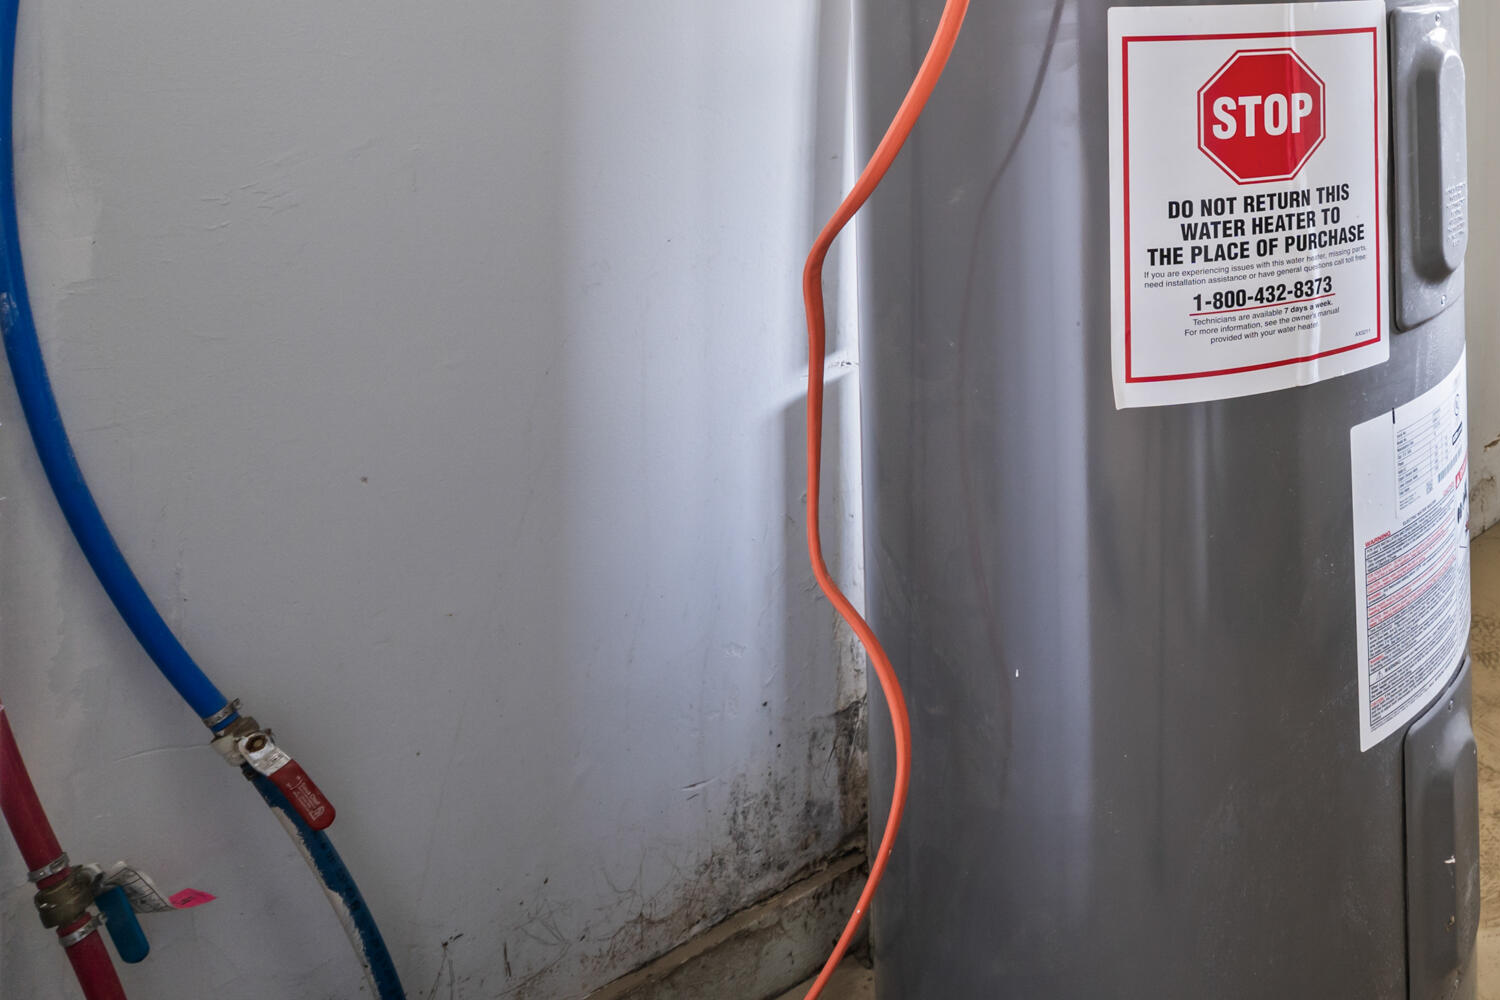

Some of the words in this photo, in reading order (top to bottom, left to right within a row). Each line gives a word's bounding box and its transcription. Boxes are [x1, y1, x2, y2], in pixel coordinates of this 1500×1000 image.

[1212, 93, 1313, 140] STOP
[1168, 200, 1194, 219] DO
[1200, 197, 1237, 217] NOT
[1243, 189, 1311, 214] RETURN
[1316, 183, 1350, 205] THIS
[1180, 218, 1246, 241] WATER
[1252, 210, 1316, 235] HEATER
[1321, 206, 1341, 225] TO
[1147, 247, 1184, 266] THE
[1191, 241, 1250, 264] PLACE
[1256, 238, 1279, 258] OF
[1284, 224, 1365, 254] PURCHASE
[1144, 281, 1164, 289] need
[1165, 278, 1206, 287] installation
[1208, 274, 1248, 284] assistance
[1258, 270, 1275, 279] have
[1276, 266, 1302, 277] general
[1304, 261, 1333, 273] queions
[1334, 258, 1345, 266] call
[1345, 256, 1355, 264] toll
[1151, 272, 1165, 280] you
[1181, 266, 1229, 277] experiencing
[1231, 264, 1255, 272] issues
[1256, 261, 1271, 269] with
[1272, 259, 1285, 267] this
[1286, 257, 1305, 265] water
[1306, 253, 1327, 262] heter,
[1328, 248, 1351, 258] missing
[1193, 275, 1333, 311] 1-800-432-8373
[1193, 316, 1237, 326] Technicians
[1252, 309, 1283, 319] available
[1290, 304, 1308, 313] days
[1199, 327, 1219, 335] more
[1220, 322, 1263, 333] information,
[1264, 319, 1278, 327] see
[1279, 317, 1290, 325] the
[1317, 307, 1340, 318] manual
[1210, 332, 1243, 344] provided
[1244, 331, 1259, 340] with
[1260, 329, 1276, 339] your
[1277, 325, 1296, 334] water
